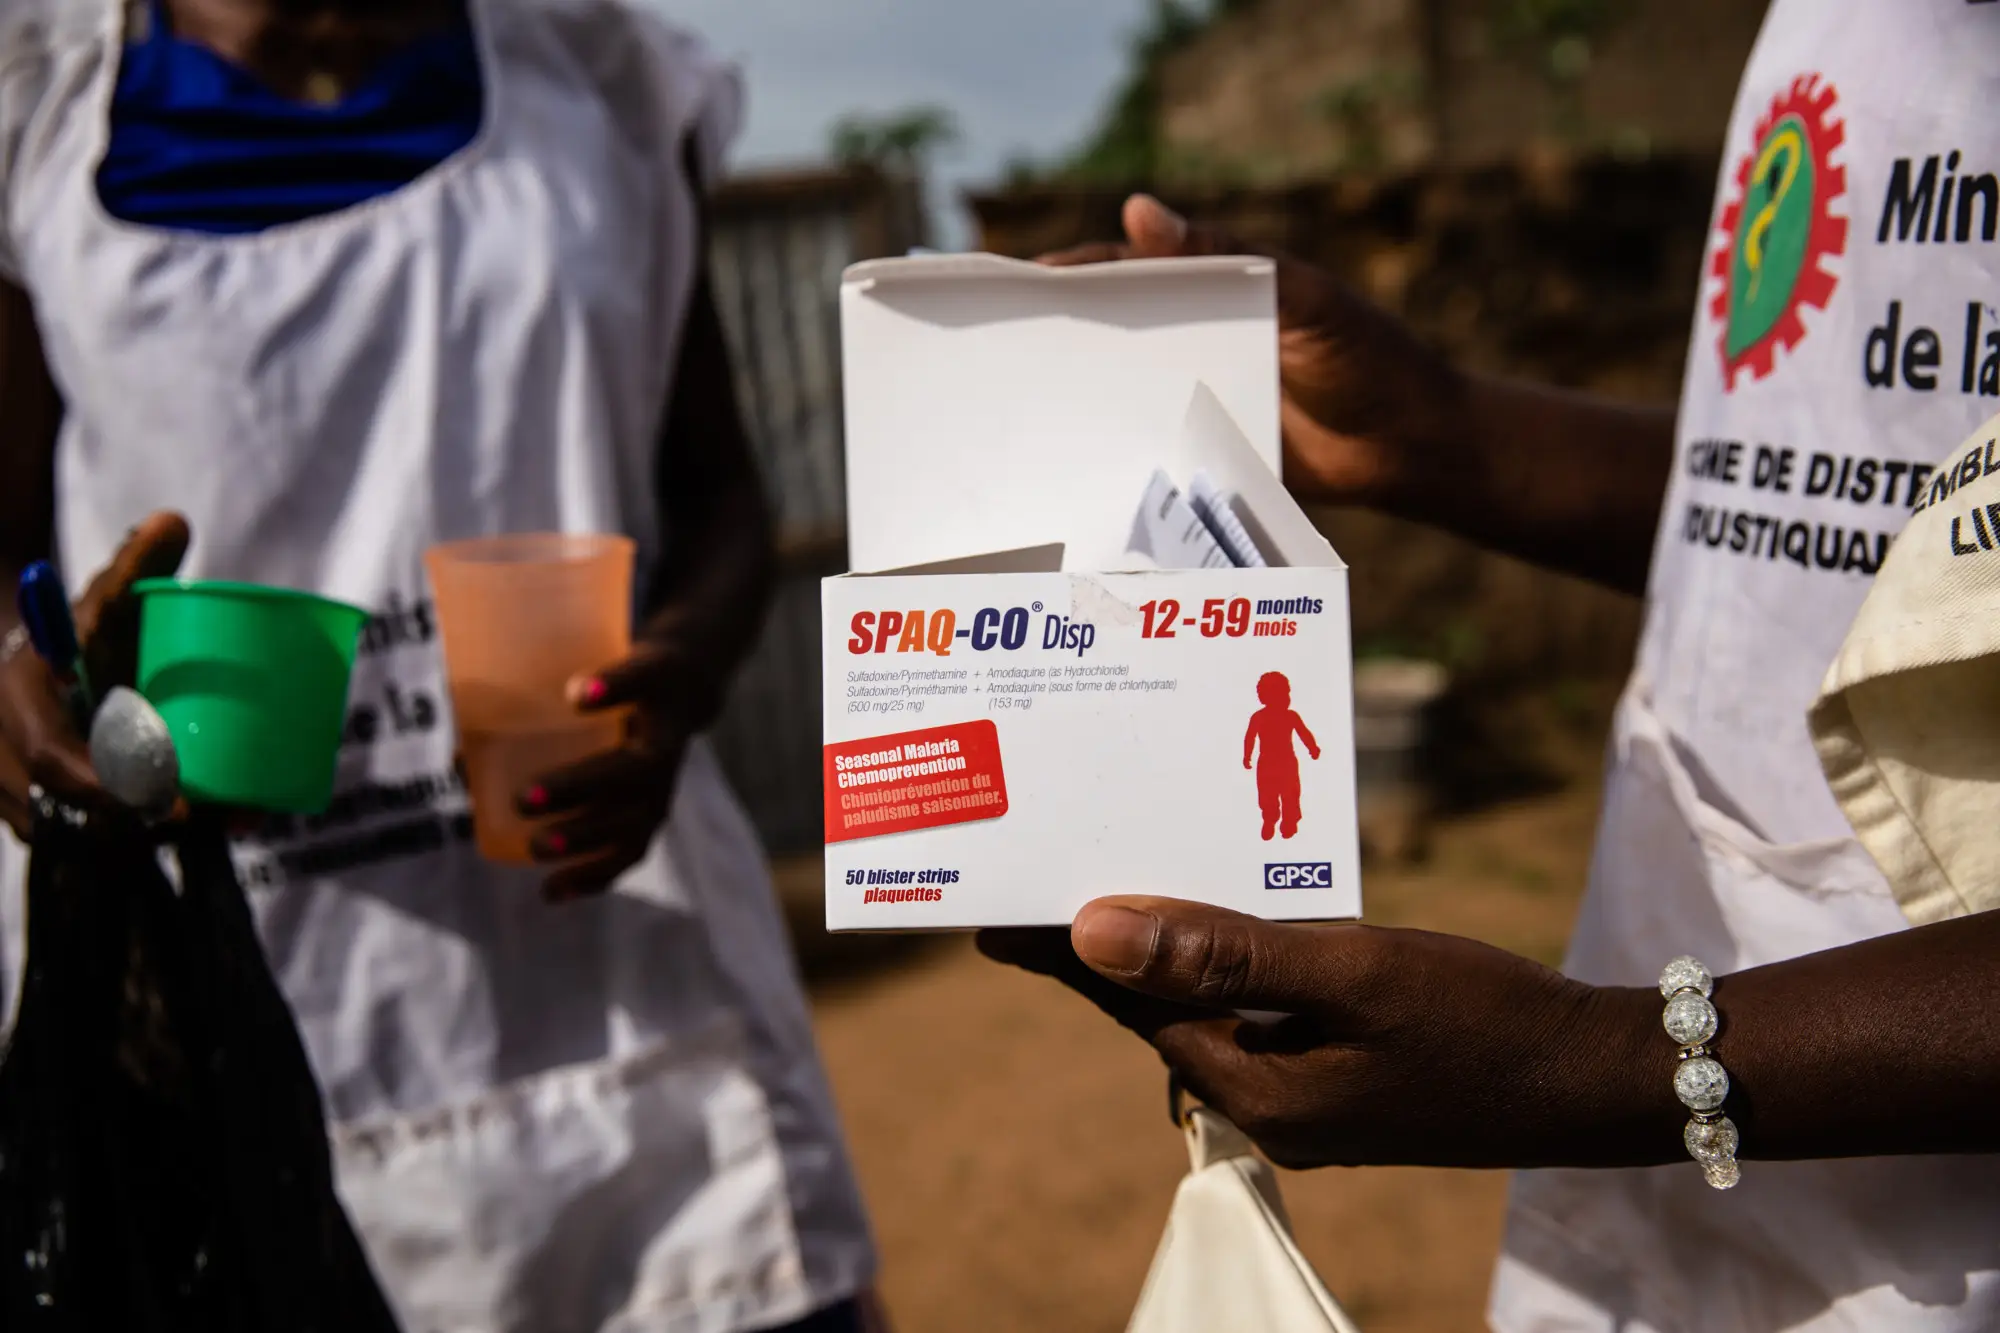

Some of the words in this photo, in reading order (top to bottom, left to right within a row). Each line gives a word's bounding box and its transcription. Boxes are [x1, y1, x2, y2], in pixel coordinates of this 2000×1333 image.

[1876, 149, 2000, 243] Min
[1864, 299, 1942, 391] de
[1752, 445, 1796, 492] DE
[1138, 597, 1251, 639] 12-59
[1256, 596, 1324, 615] months
[1042, 614, 1095, 657] Disp
[1253, 617, 1297, 637] mois
[846, 668, 968, 683] Sulfadoxine/Pyrimethamine
[973, 670, 982, 680] +
[986, 666, 1046, 680] Amodiaquine
[1048, 666, 1062, 679] (as
[1064, 664, 1130, 680] Hydrochloride)
[846, 683, 968, 698] Sulfadoxine/Pyriméthamine
[973, 685, 982, 694] +
[986, 681, 1047, 695] Amodiaquine
[1048, 681, 1074, 694] (sous
[1075, 680, 1102, 692] forme
[1104, 680, 1117, 691] de
[1119, 678, 1178, 694] chlorhydrate)
[847, 700, 871, 714] (500
[872, 700, 904, 714] mg/25
[906, 700, 925, 714] mg)
[988, 697, 1012, 711] (153
[1013, 697, 1033, 710] mg)
[835, 746, 901, 771] Seasonal
[903, 738, 960, 760] Malaria
[837, 756, 967, 789] Chemoprevention
[840, 778, 970, 810] Chimioprévention
[972, 773, 992, 788] du
[843, 802, 920, 829] paludisme
[922, 790, 1003, 815] saisonnier.
[845, 869, 865, 885] 50
[866, 869, 915, 885] blister
[917, 868, 960, 885] strips
[1267, 864, 1330, 887] GPSC
[863, 887, 943, 905] plaquettes
